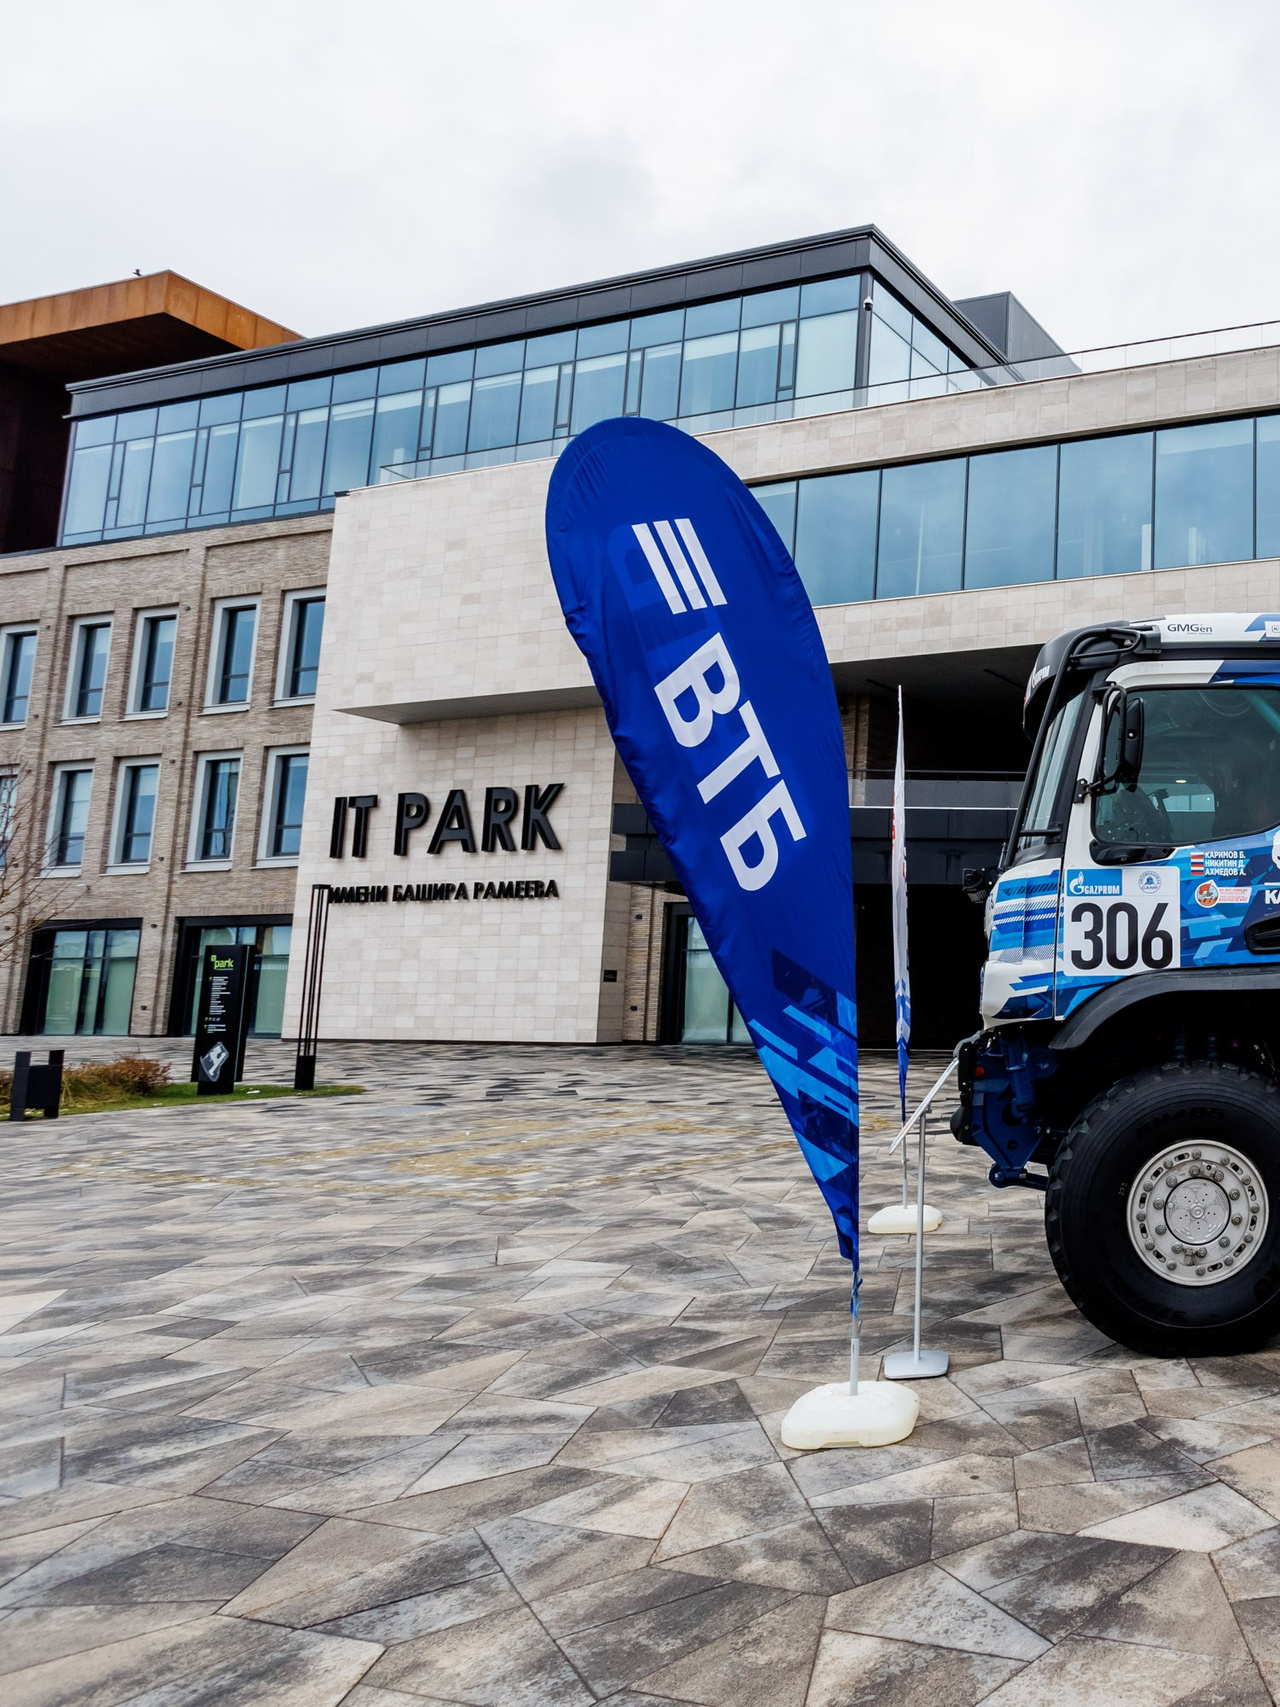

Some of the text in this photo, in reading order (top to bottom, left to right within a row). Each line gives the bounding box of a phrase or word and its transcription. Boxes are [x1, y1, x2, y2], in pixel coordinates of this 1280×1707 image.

[1167, 623, 1213, 633] GMGen
[653, 631, 807, 892] ВТБ
[329, 783, 565, 859] IT PARK
[1205, 851, 1238, 859] КАРИМОВ
[1205, 859, 1237, 867] НИКИТИН
[1205, 868, 1238, 877] АХМЕДОВ
[329, 879, 559, 904] ИМЕНИ БАШИРА РАМЕЕВА
[1084, 885, 1120, 895] GAZPROM
[1071, 902, 1173, 970] 306
[213, 958, 234, 970] park
